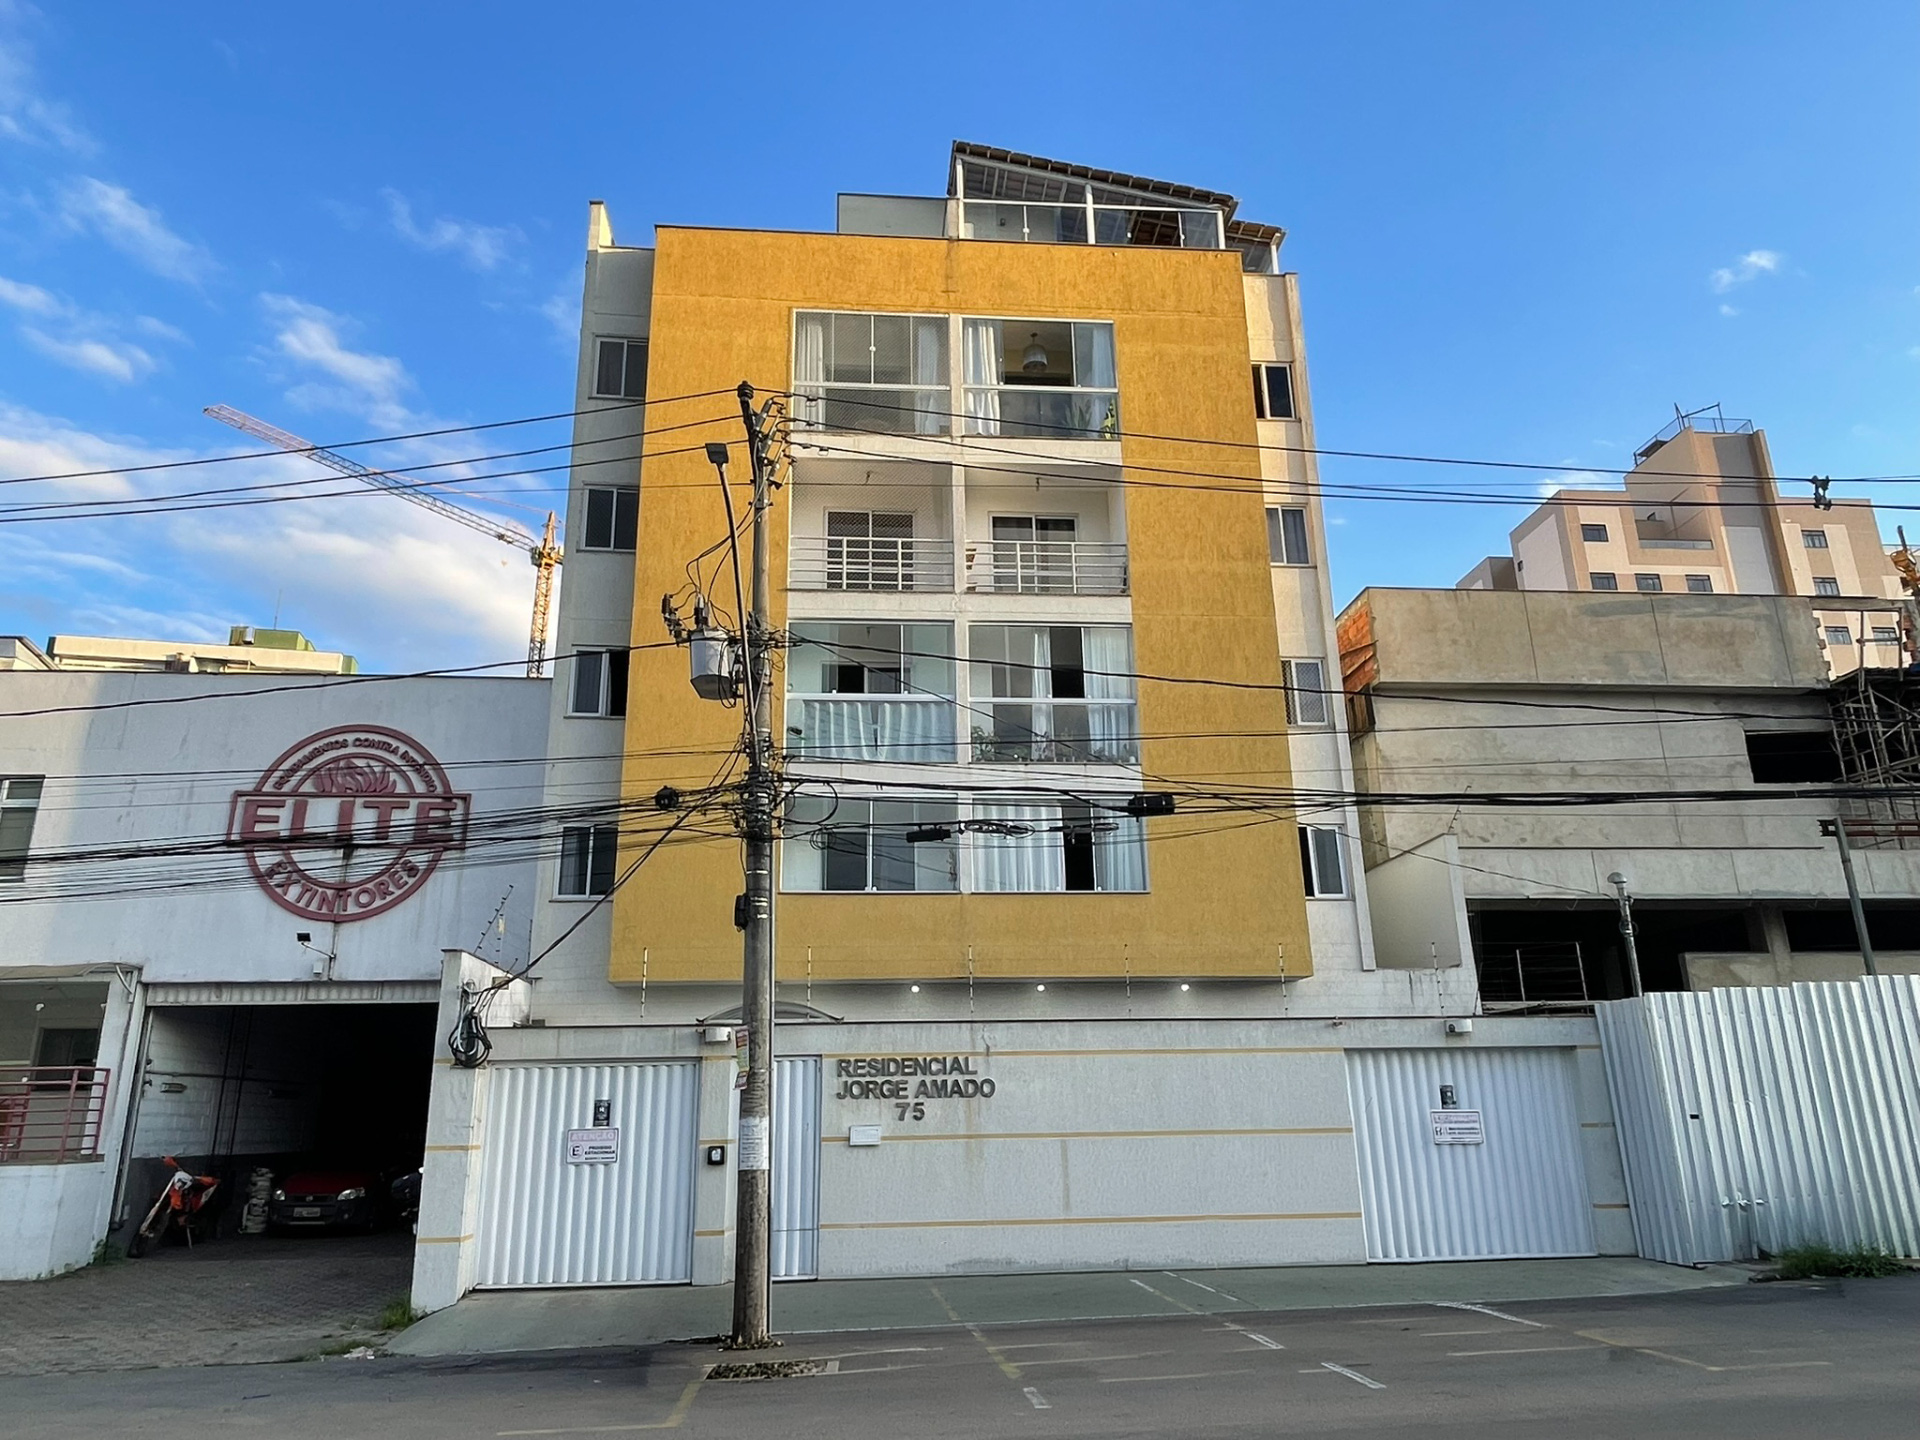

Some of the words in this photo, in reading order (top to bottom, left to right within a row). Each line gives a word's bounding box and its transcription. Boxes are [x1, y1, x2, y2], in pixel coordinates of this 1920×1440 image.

[353, 737, 400, 756] CONTRA
[240, 798, 457, 843] ELITE
[264, 858, 420, 913] EXTINTORES
[836, 1056, 978, 1077] RESIDENCIAL
[836, 1079, 909, 1100] JORGE
[914, 1078, 996, 1099] AMADO
[895, 1102, 926, 1122] 75
